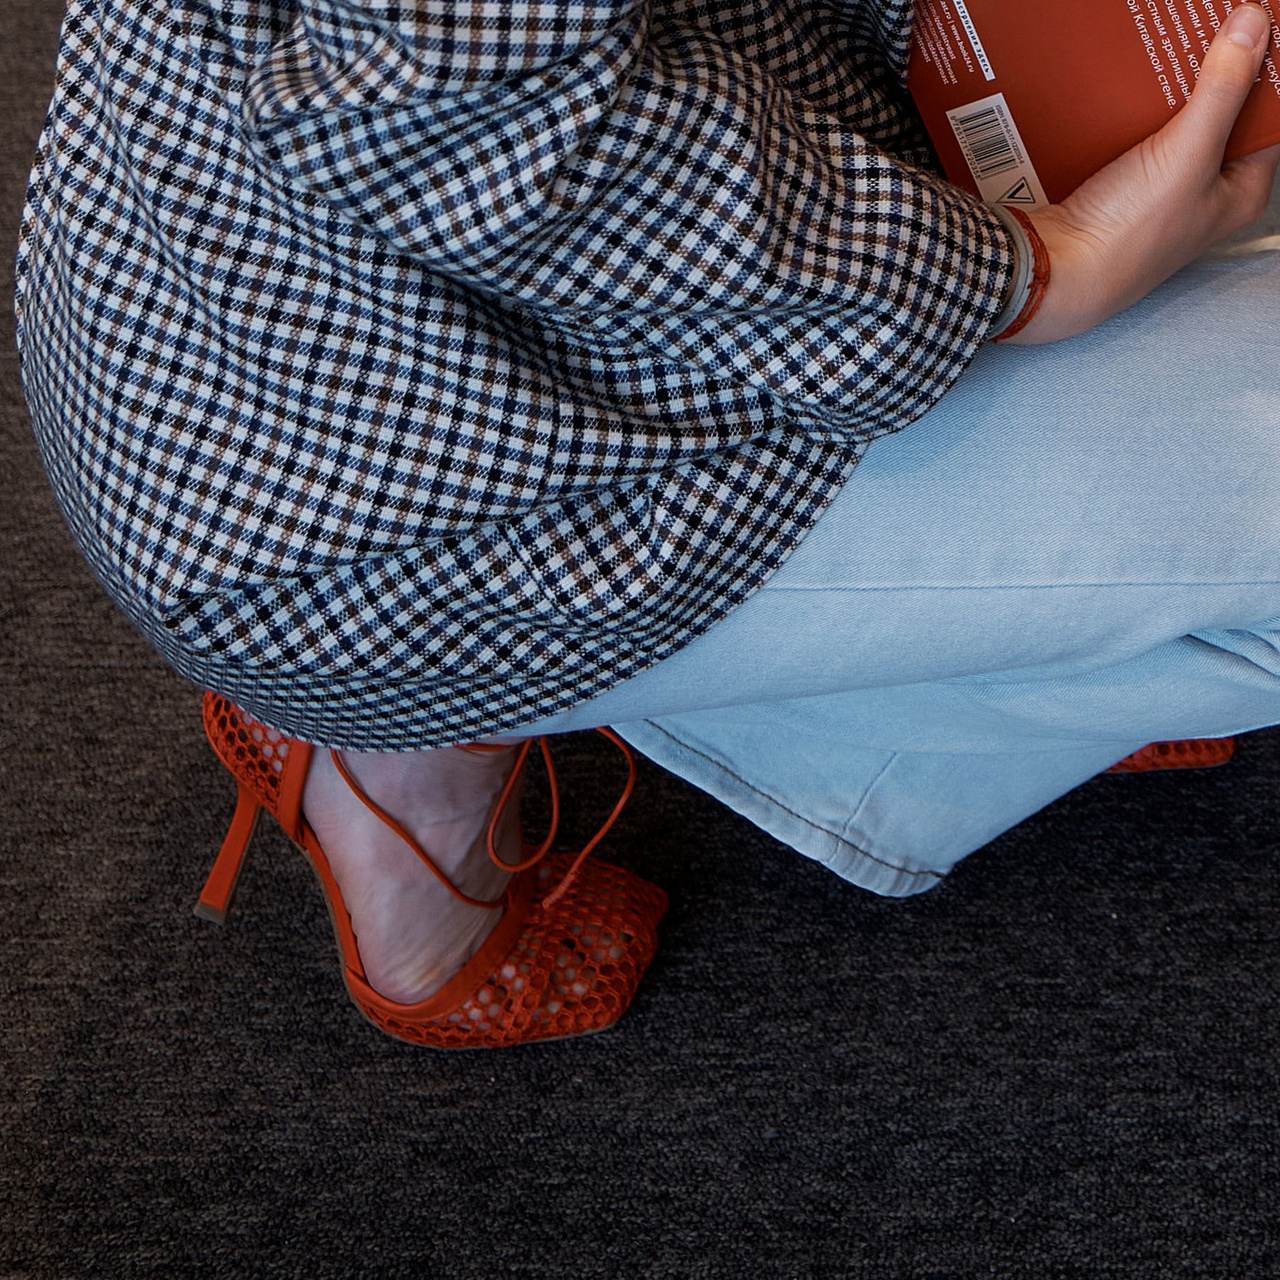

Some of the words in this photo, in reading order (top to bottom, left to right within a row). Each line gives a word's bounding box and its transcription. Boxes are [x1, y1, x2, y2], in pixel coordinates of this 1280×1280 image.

[1222, 0, 1233, 15] лю
[1196, 29, 1206, 38] и
[949, 23, 975, 74] www.book24.ru
[975, 47, 991, 73] здесь
[1133, 13, 1165, 73] Китайской
[1157, 74, 1176, 109] стене.
[1187, 53, 1200, 79] кото
